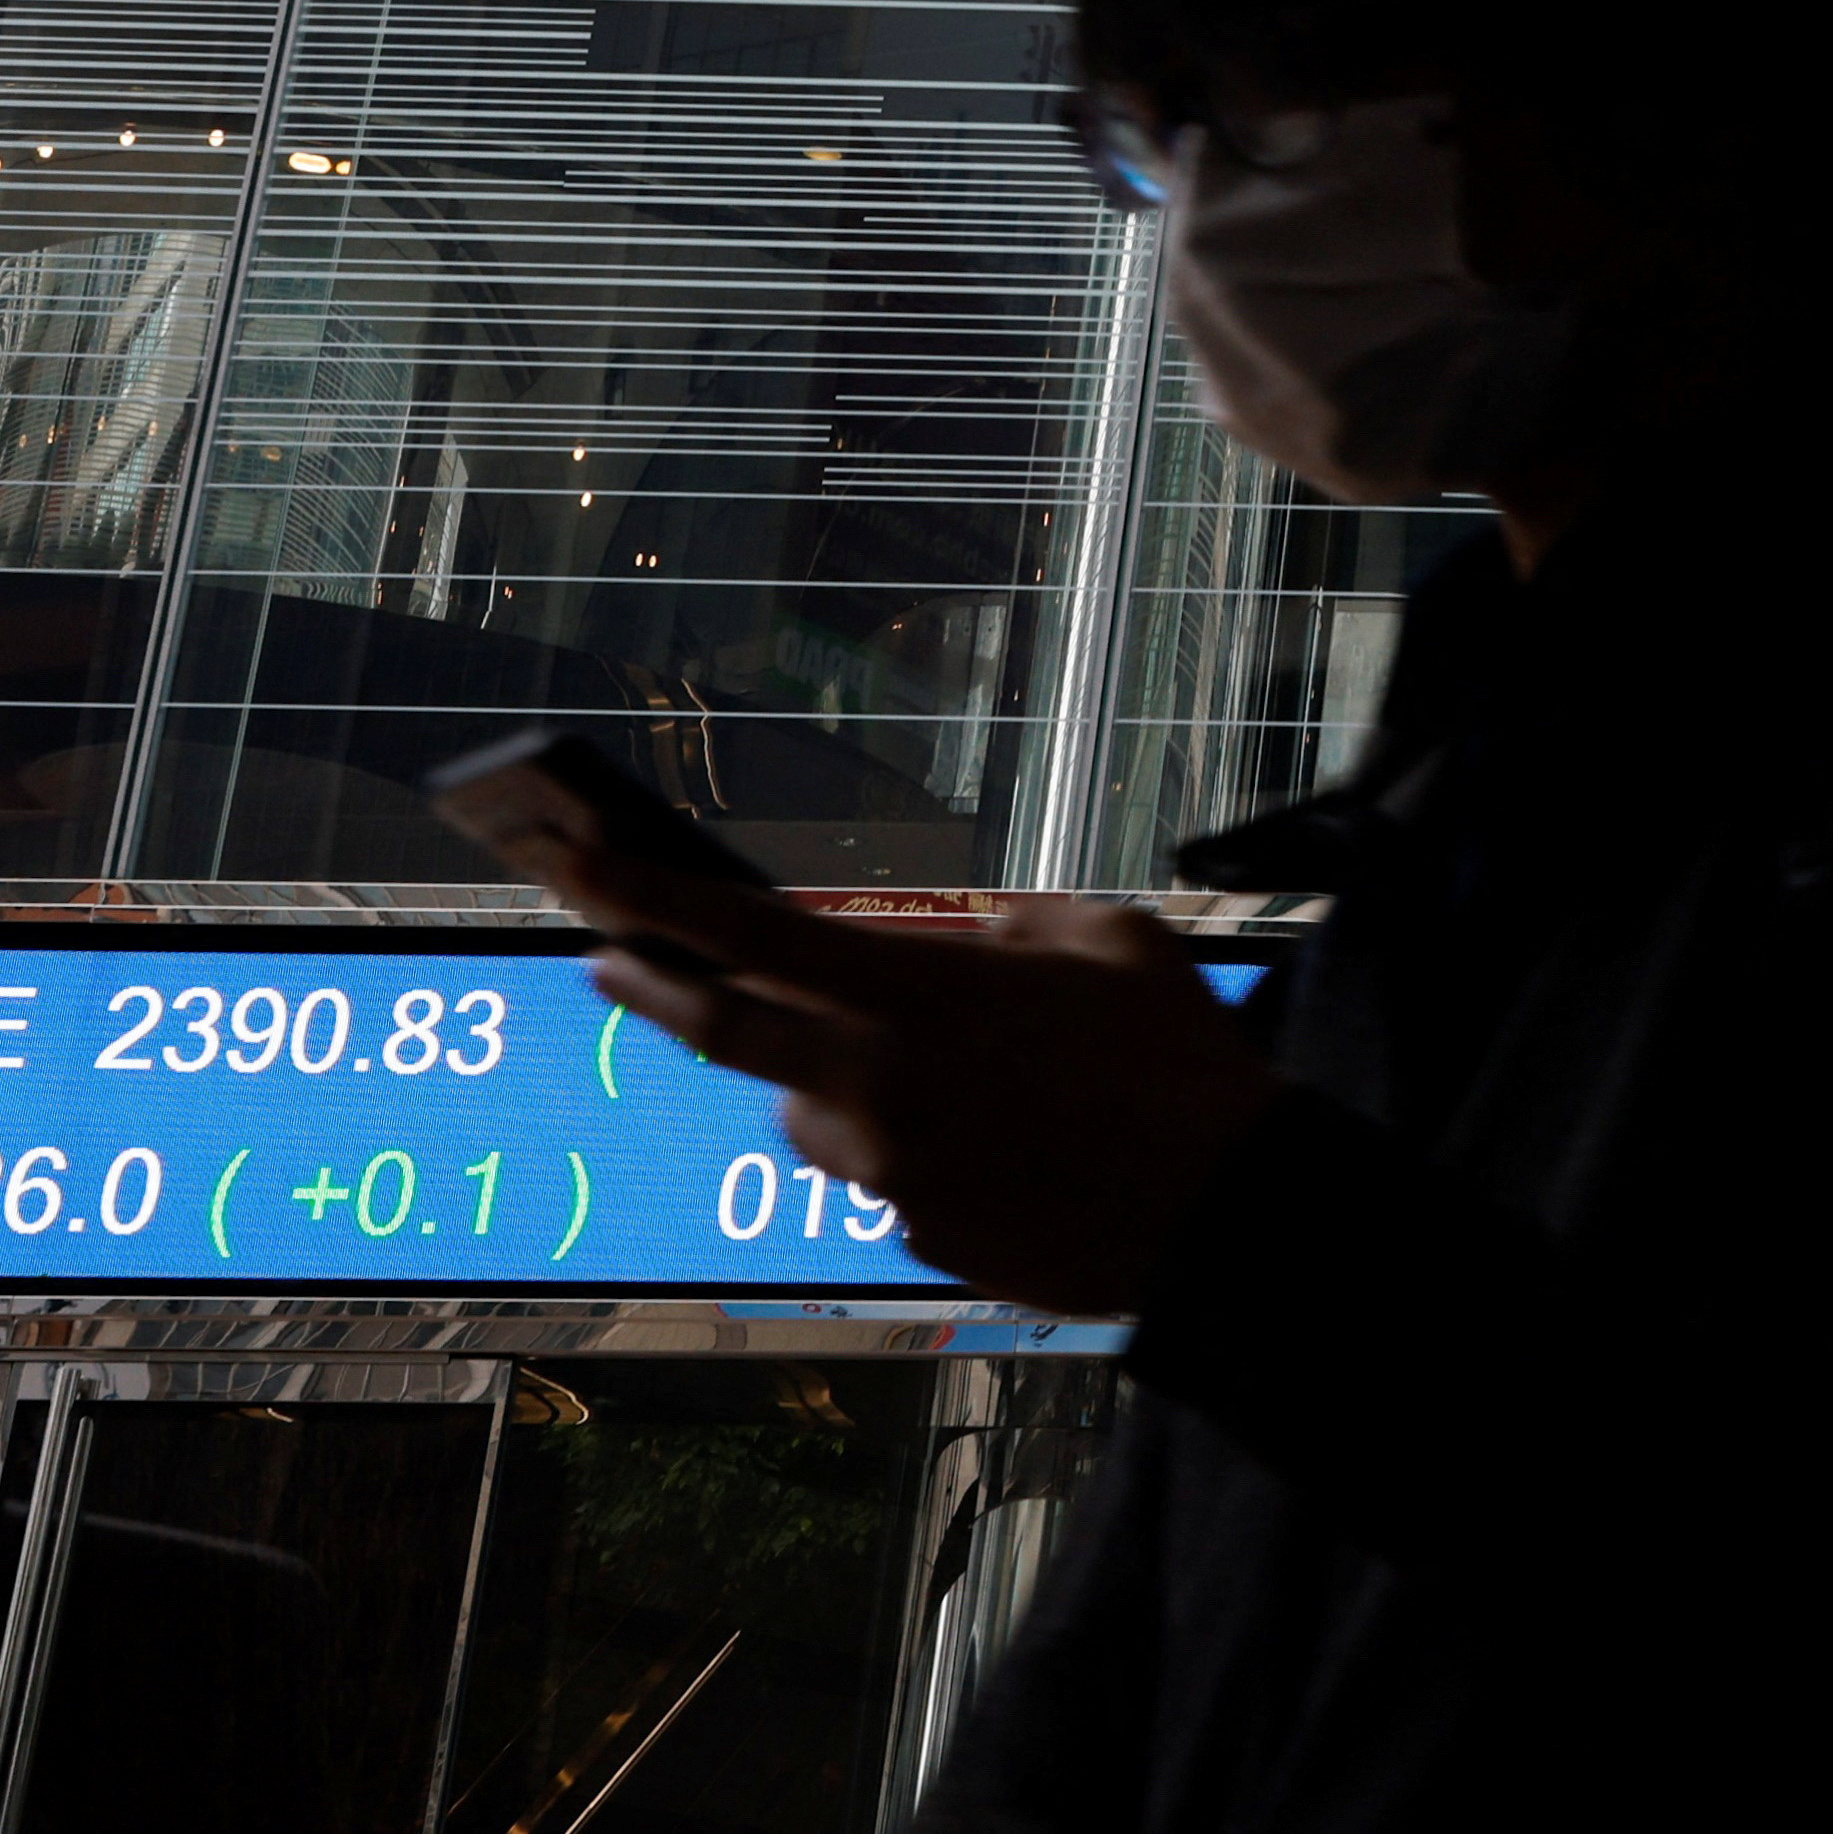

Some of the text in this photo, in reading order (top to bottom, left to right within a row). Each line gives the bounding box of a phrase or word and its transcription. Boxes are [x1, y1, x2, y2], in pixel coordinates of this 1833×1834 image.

[95, 986, 506, 1075] 2390.83
[0, 1147, 499, 1235] 6.0 +0.1
